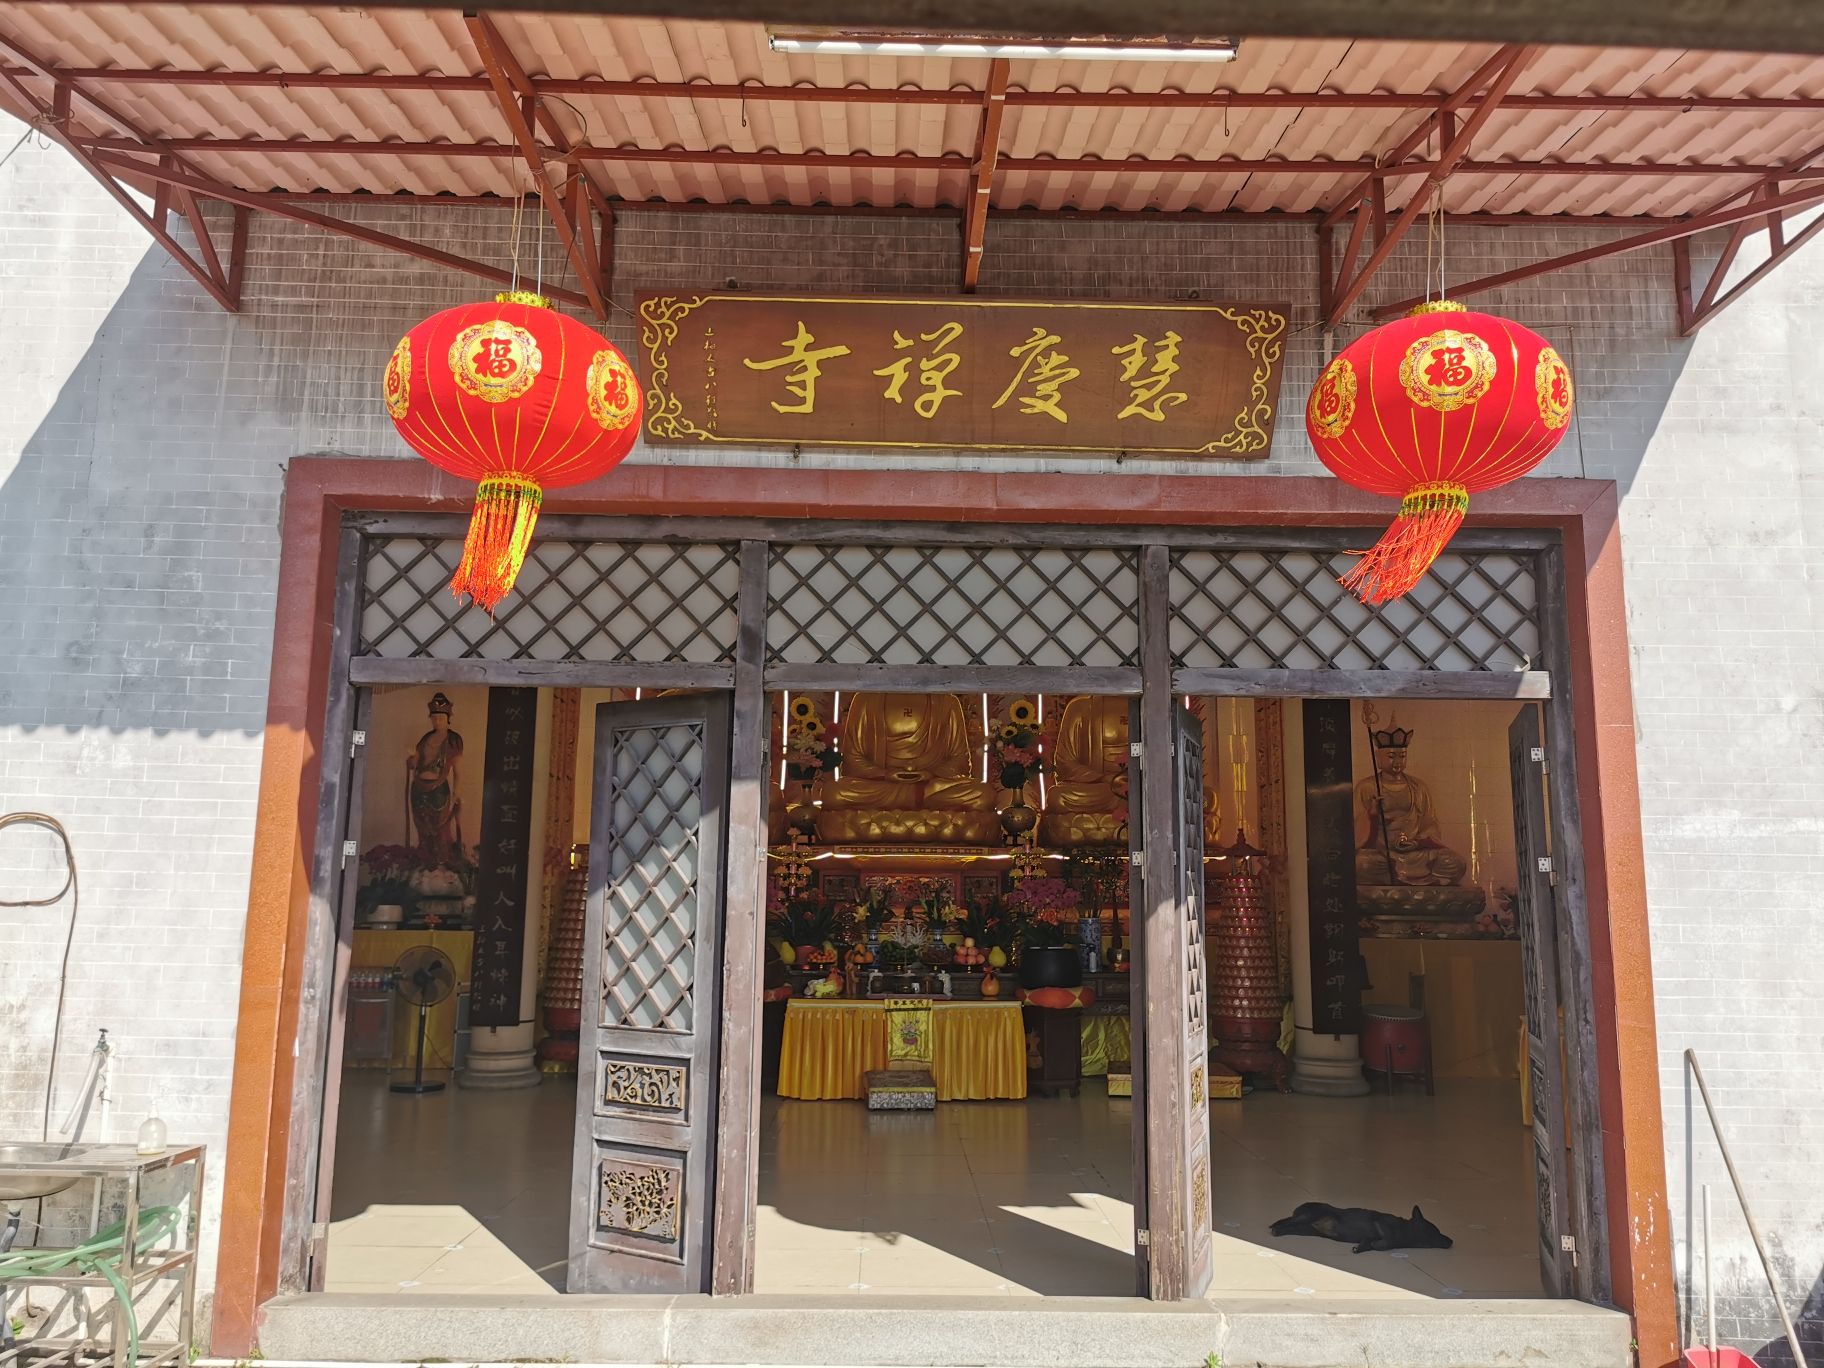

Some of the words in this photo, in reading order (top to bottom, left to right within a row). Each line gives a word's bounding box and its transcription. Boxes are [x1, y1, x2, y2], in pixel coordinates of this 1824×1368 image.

[471, 337, 518, 379] 福
[1424, 346, 1473, 388] 福
[603, 368, 629, 409] 福
[1316, 377, 1341, 419] 福
[1550, 364, 1568, 406] 福
